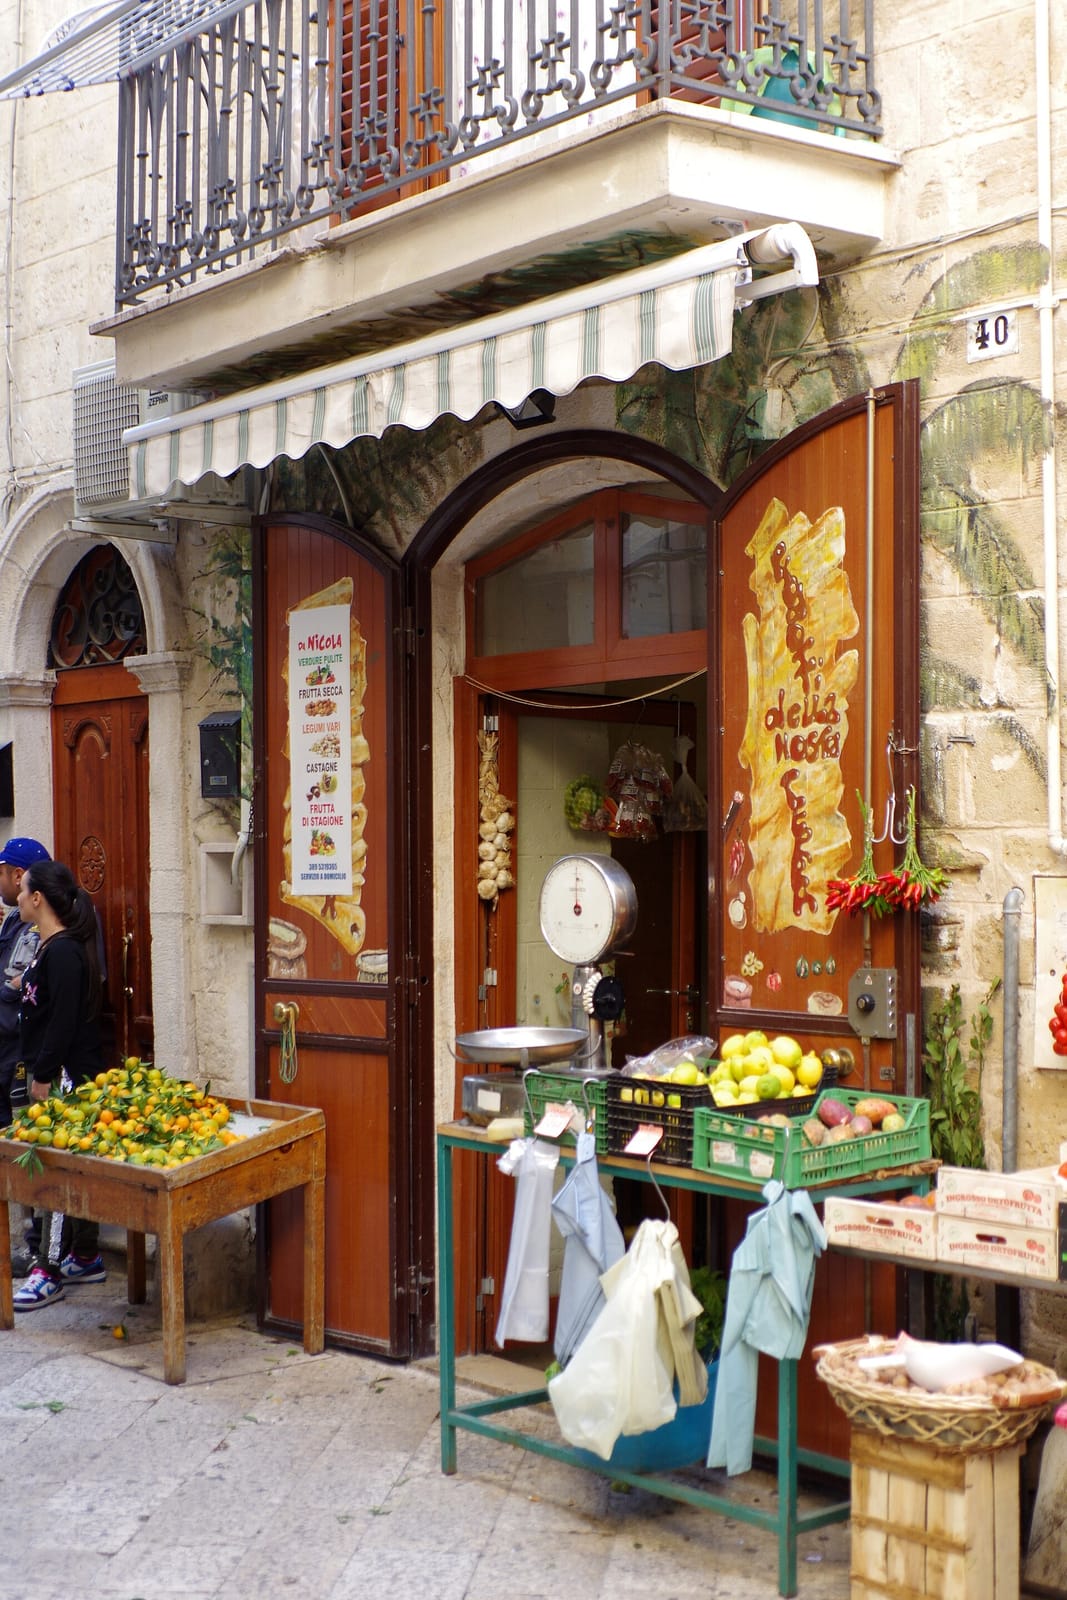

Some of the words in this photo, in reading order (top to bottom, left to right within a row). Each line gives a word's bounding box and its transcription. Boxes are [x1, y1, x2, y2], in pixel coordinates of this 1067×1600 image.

[975, 315, 1009, 350] 40
[298, 656, 322, 666] VERDURE
[324, 653, 343, 664] PULITE
[299, 688, 322, 699] FRUTTA
[322, 685, 343, 697] SECCA
[303, 723, 326, 734] LEGUMI
[326, 720, 341, 732] VARI
[306, 761, 338, 773] CASTAGNE
[310, 804, 335, 814] FRUTTA
[302, 817, 309, 826] DI
[310, 816, 344, 826] STAGIONE
[946, 1193, 987, 1204] INGROSSO
[987, 1196, 1043, 1217] ORTOFRUTTA
[834, 1223, 872, 1233] INGROSSO
[872, 1226, 923, 1245] ORTOFRUTTA
[949, 1242, 990, 1252] INGROSSO
[990, 1245, 1046, 1266] ORTOFRUTTA
